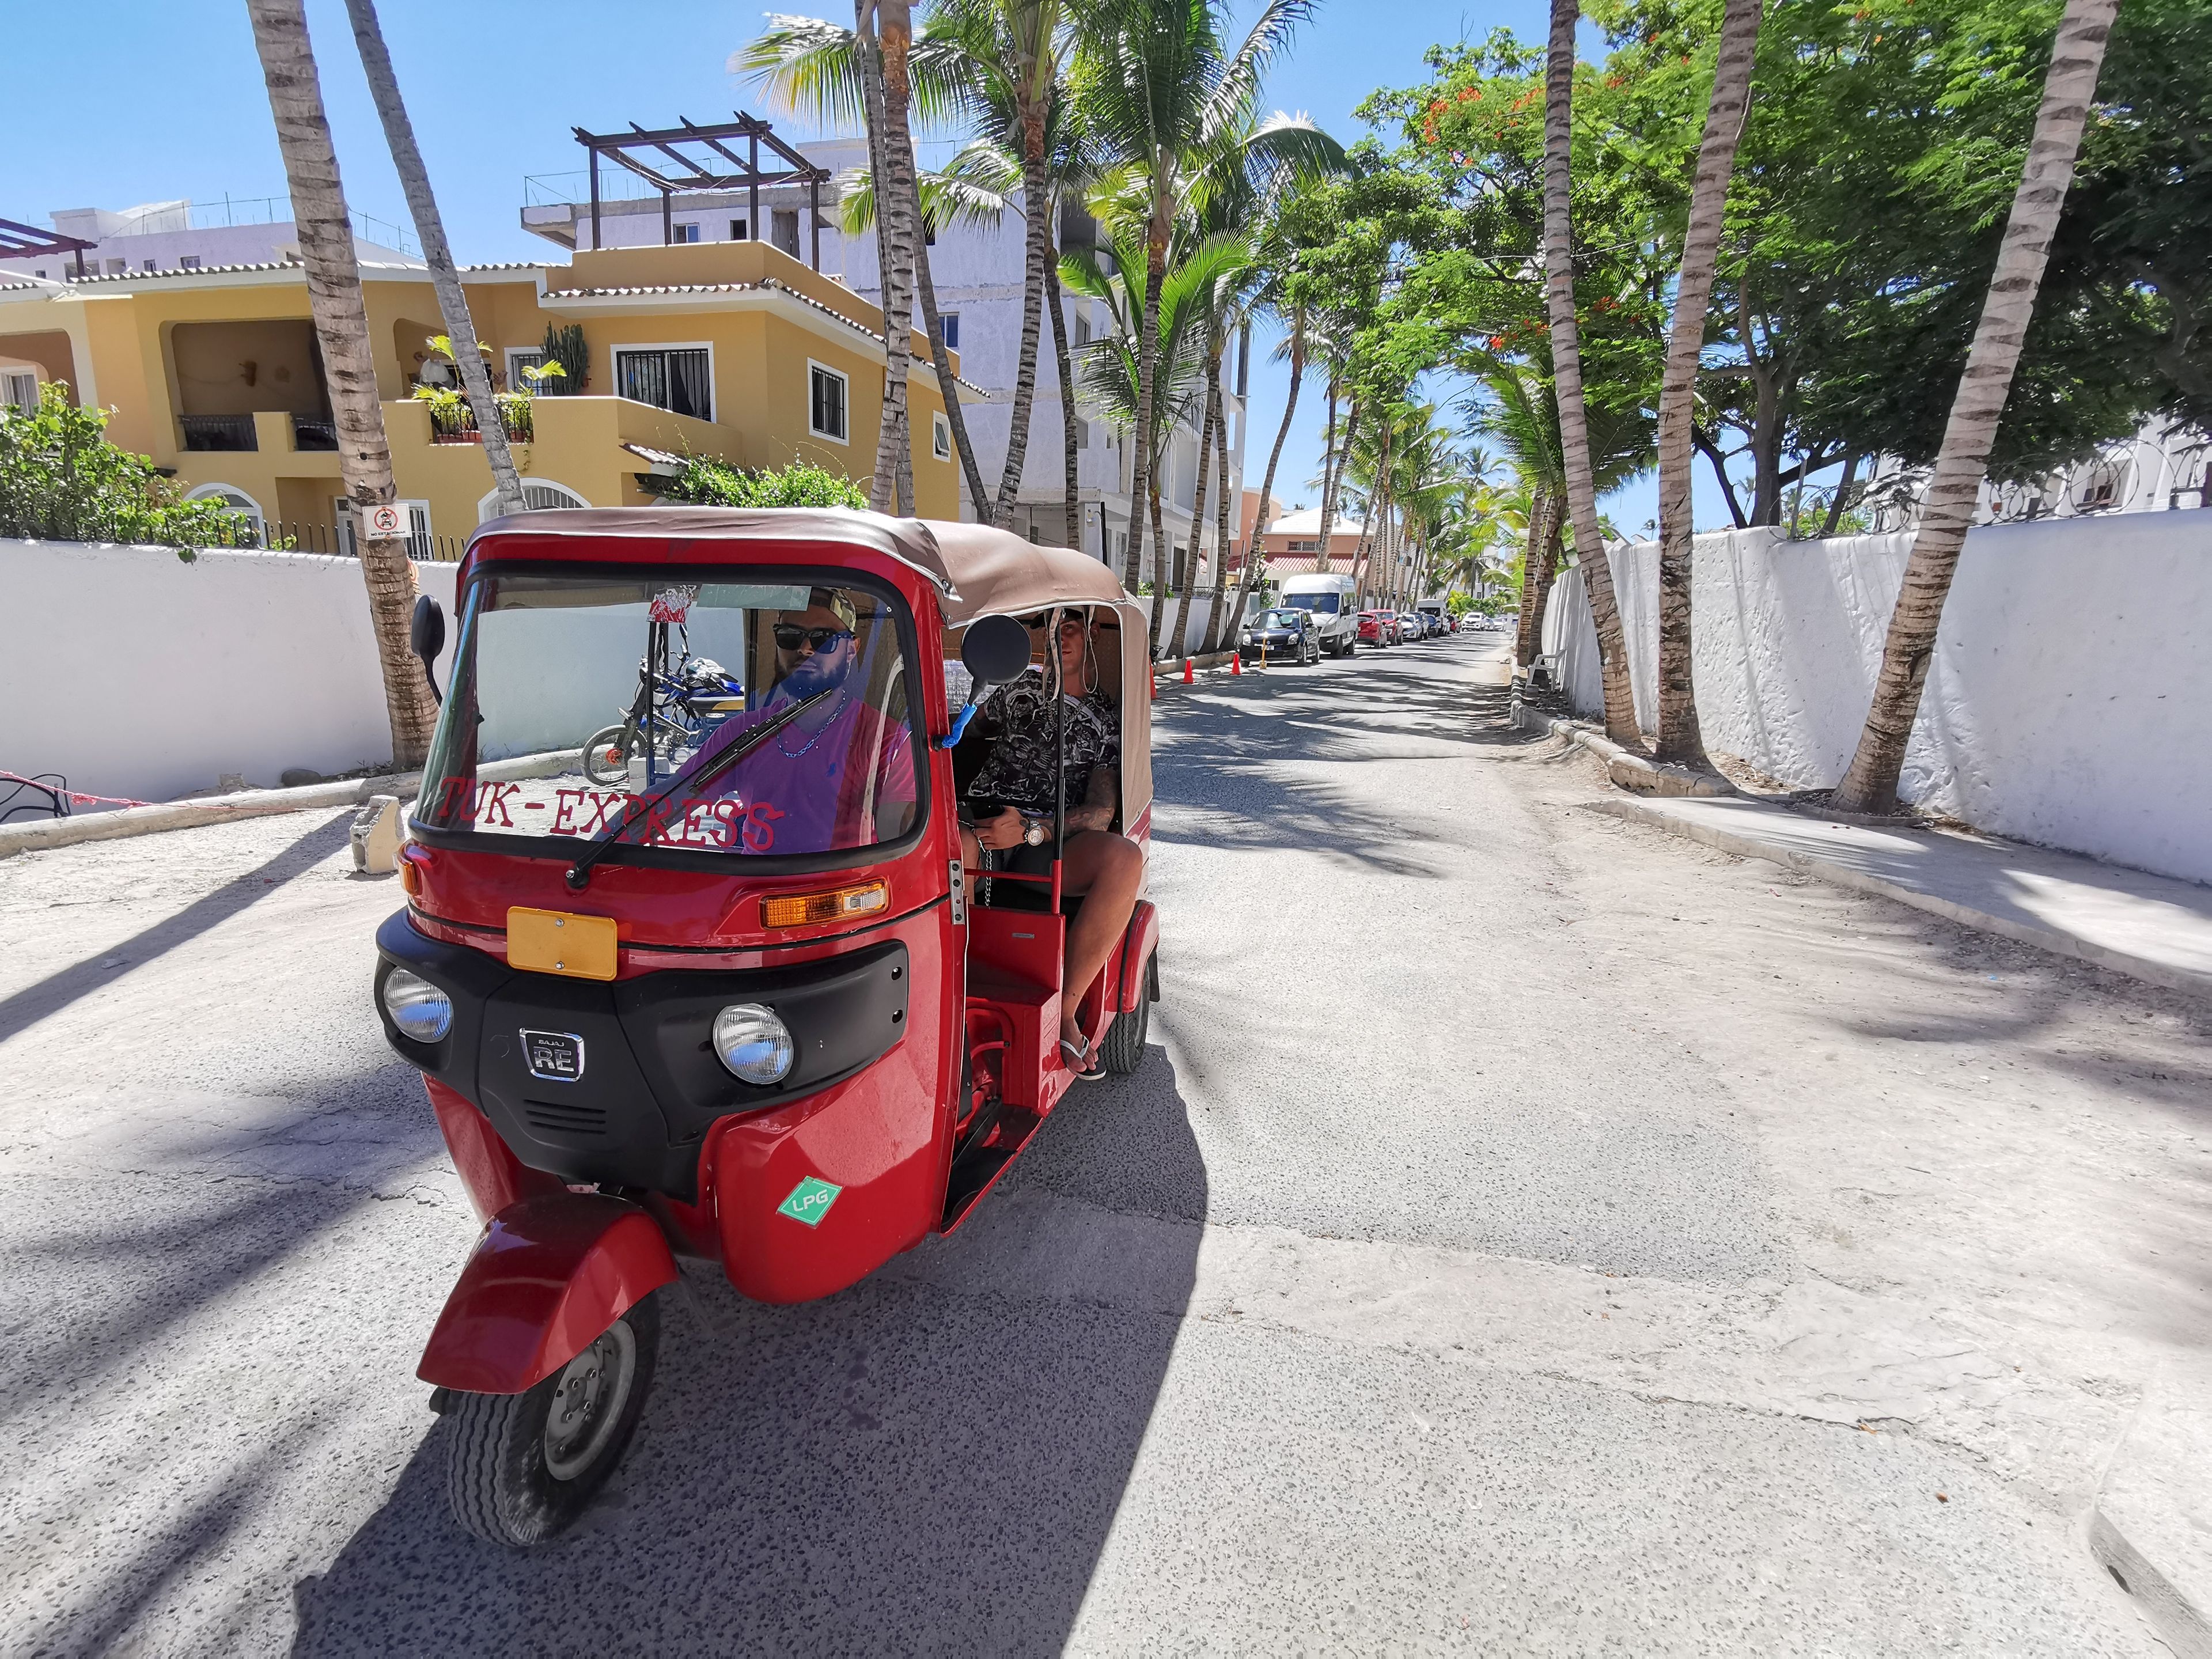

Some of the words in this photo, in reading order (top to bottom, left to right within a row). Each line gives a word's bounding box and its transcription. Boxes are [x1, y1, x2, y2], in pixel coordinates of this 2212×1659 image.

[538, 1039, 565, 1047] BAJAJ
[533, 1046, 574, 1072] RE
[792, 1188, 829, 1212] LPG
